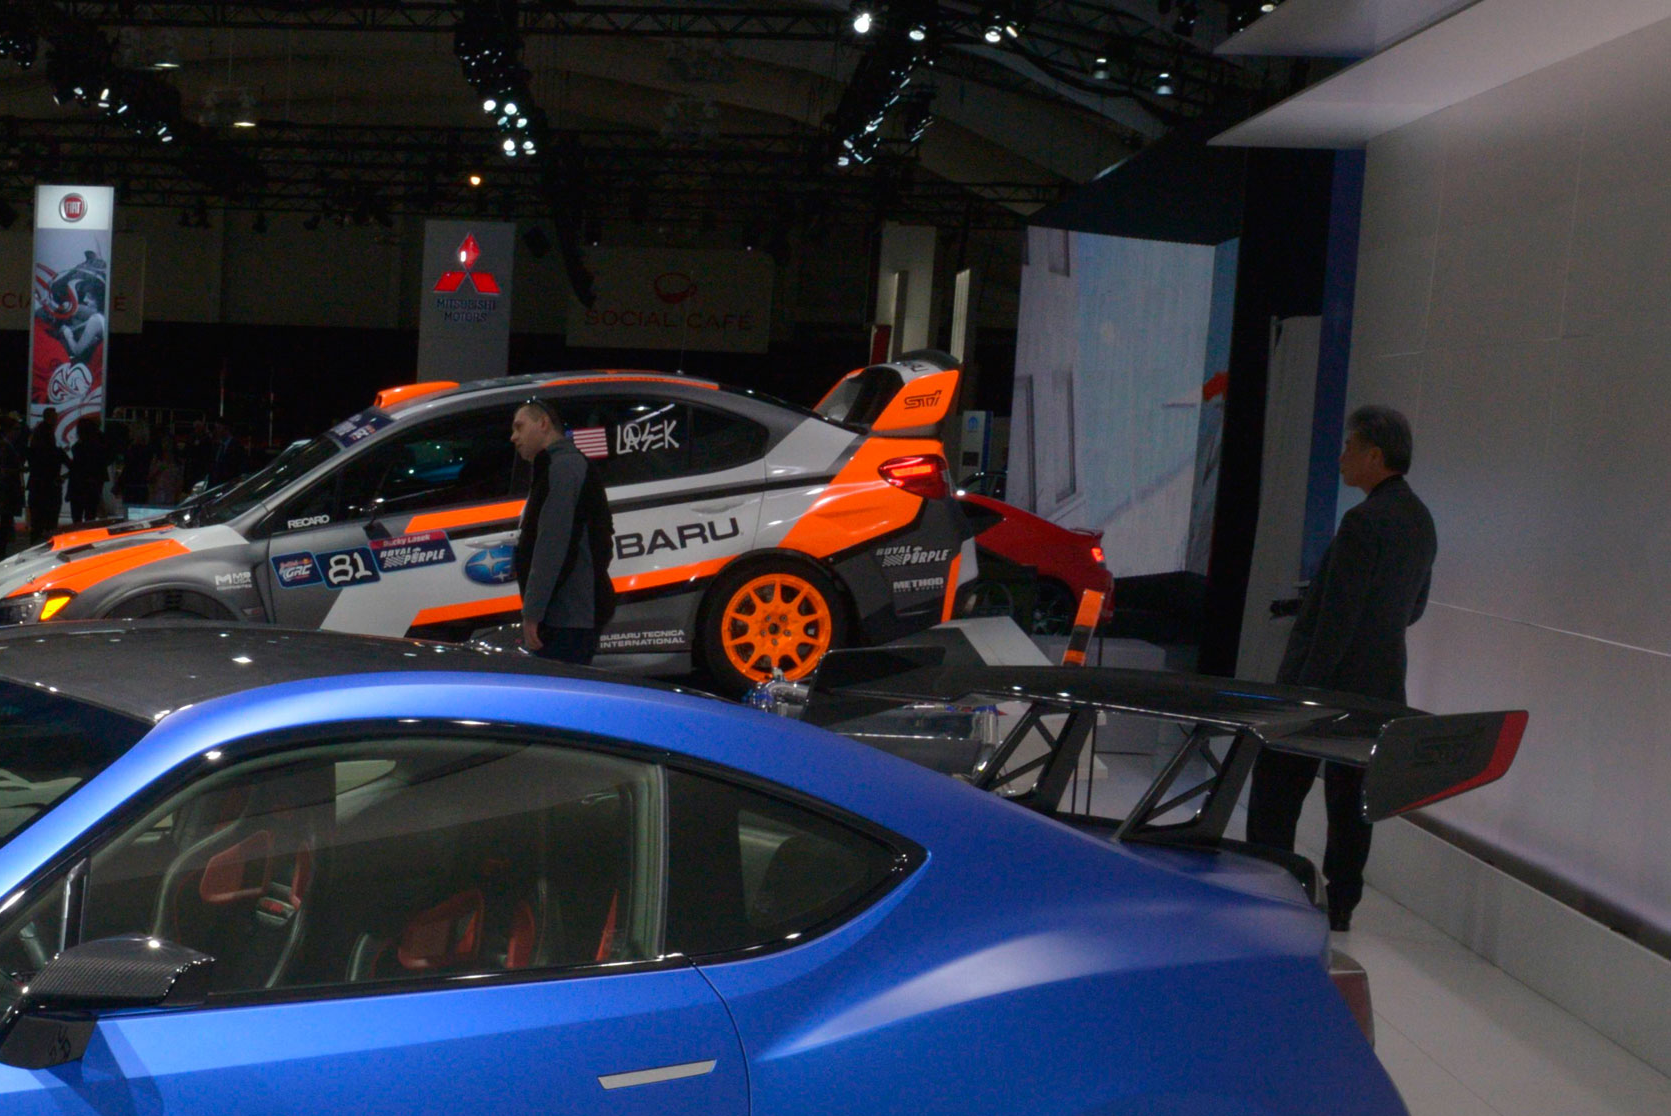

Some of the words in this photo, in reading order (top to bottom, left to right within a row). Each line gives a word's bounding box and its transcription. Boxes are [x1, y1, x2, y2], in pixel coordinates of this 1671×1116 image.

[444, 311, 488, 322] MOTORS
[585, 310, 678, 328] SOCIAL
[287, 514, 330, 529] RECARO
[614, 517, 740, 560] BARU
[403, 549, 446, 565] PURPLE
[902, 549, 949, 565] PURPLE
[329, 552, 373, 585] 81
[893, 577, 944, 589] METHOD
[599, 632, 641, 642] SUBARU
[642, 629, 685, 638] TECNICA
[600, 637, 686, 648] INTERNATIONAL
